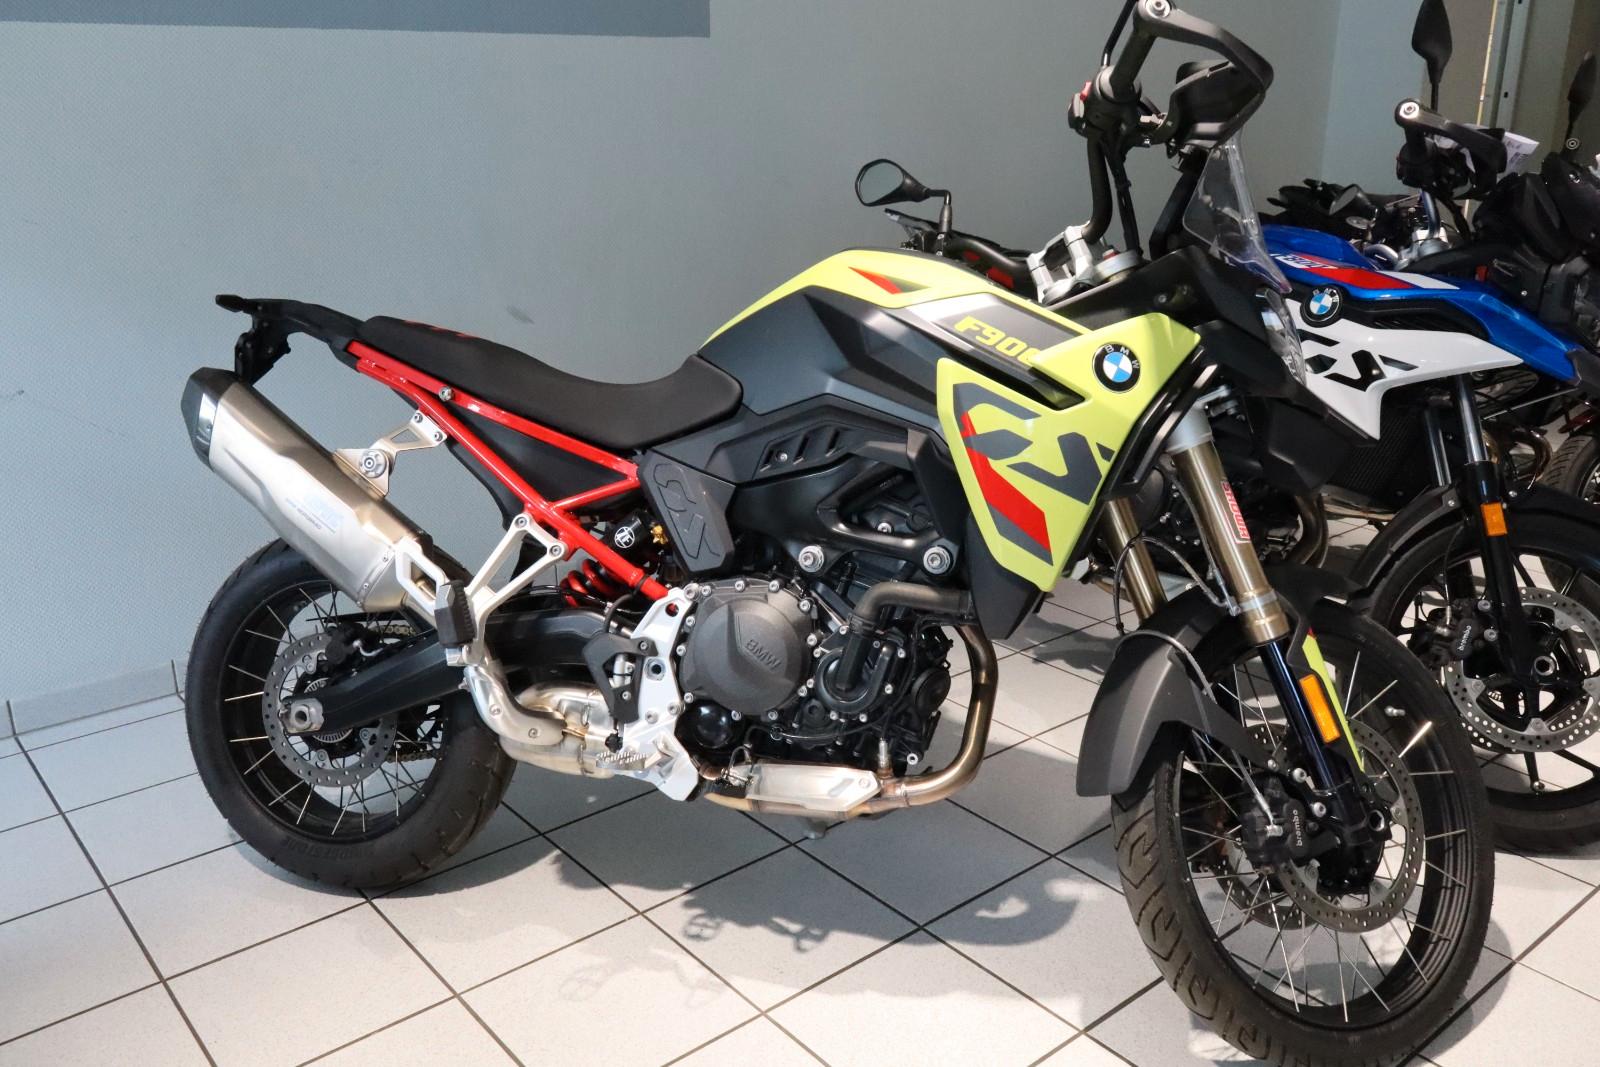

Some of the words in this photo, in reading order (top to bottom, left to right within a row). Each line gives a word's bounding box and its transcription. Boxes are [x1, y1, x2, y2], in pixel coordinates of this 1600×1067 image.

[1104, 343, 1140, 370] BMW
[1457, 625, 1471, 651] brembo
[745, 639, 781, 671] BMW
[1292, 809, 1303, 847] brembo
